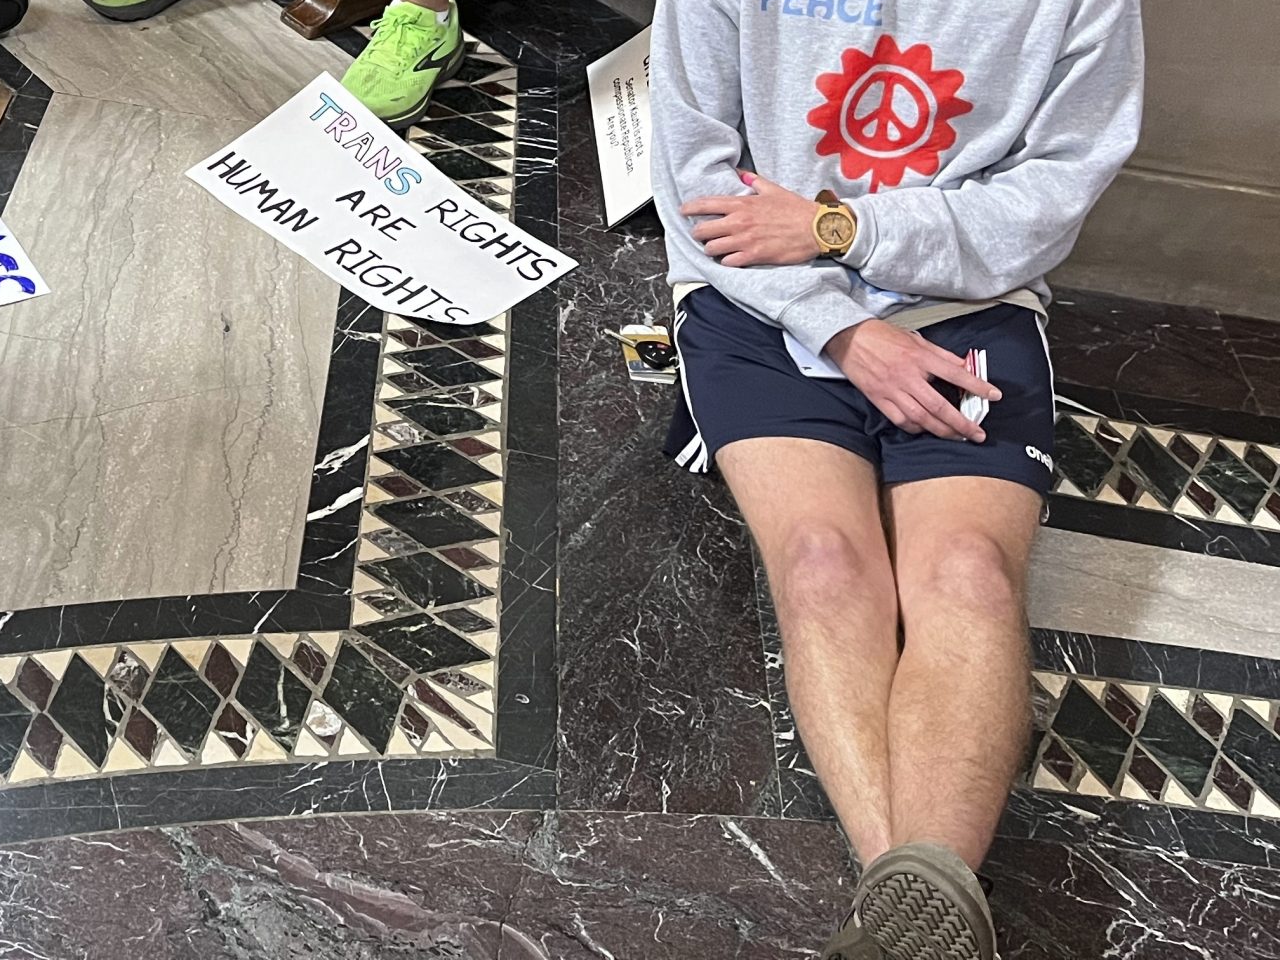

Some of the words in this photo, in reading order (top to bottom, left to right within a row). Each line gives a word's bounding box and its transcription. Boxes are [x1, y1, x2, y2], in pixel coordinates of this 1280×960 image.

[625, 77, 636, 107] Senator
[206, 150, 320, 233] HUMAN
[323, 238, 470, 324] RIGHTS
[308, 92, 422, 197] TRANS
[424, 197, 559, 282] RIGHTS
[335, 189, 418, 243] ARE
